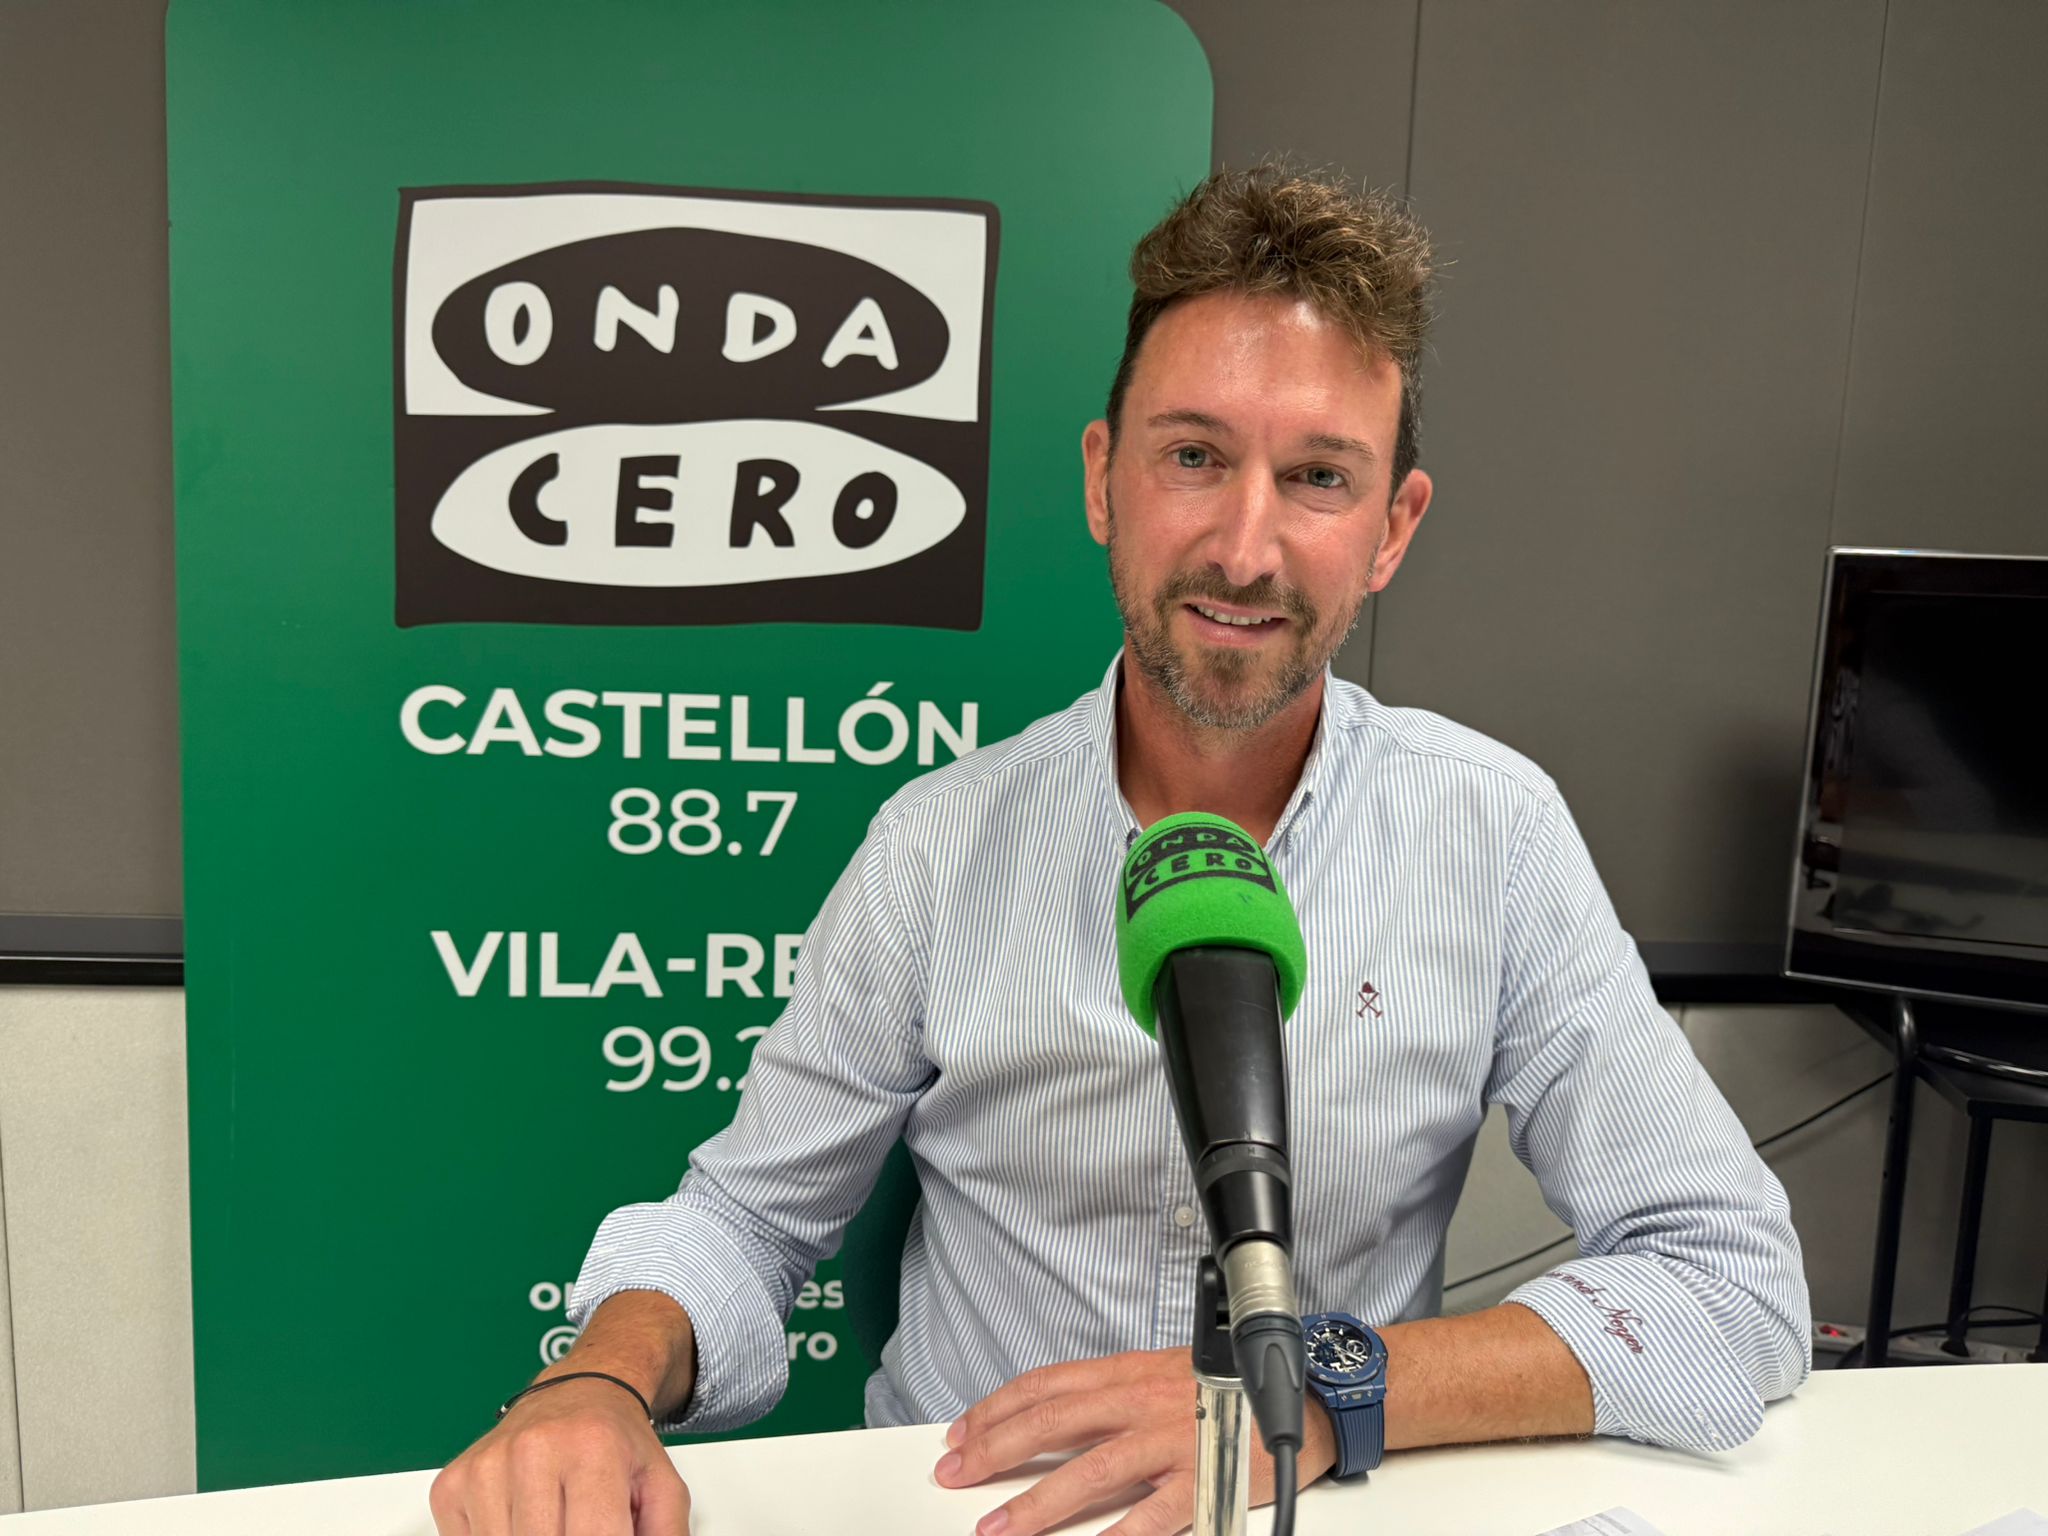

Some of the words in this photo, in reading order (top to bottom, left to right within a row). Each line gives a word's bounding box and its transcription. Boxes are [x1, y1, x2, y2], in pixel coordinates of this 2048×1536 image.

[484, 281, 899, 370] ONDA
[508, 453, 898, 549] CERO
[399, 682, 979, 766] CASTELLÓN
[607, 787, 798, 857] 88.7
[1137, 832, 1245, 867] ONDA
[1144, 852, 1252, 885] CERO
[431, 930, 806, 998] VILA-RE
